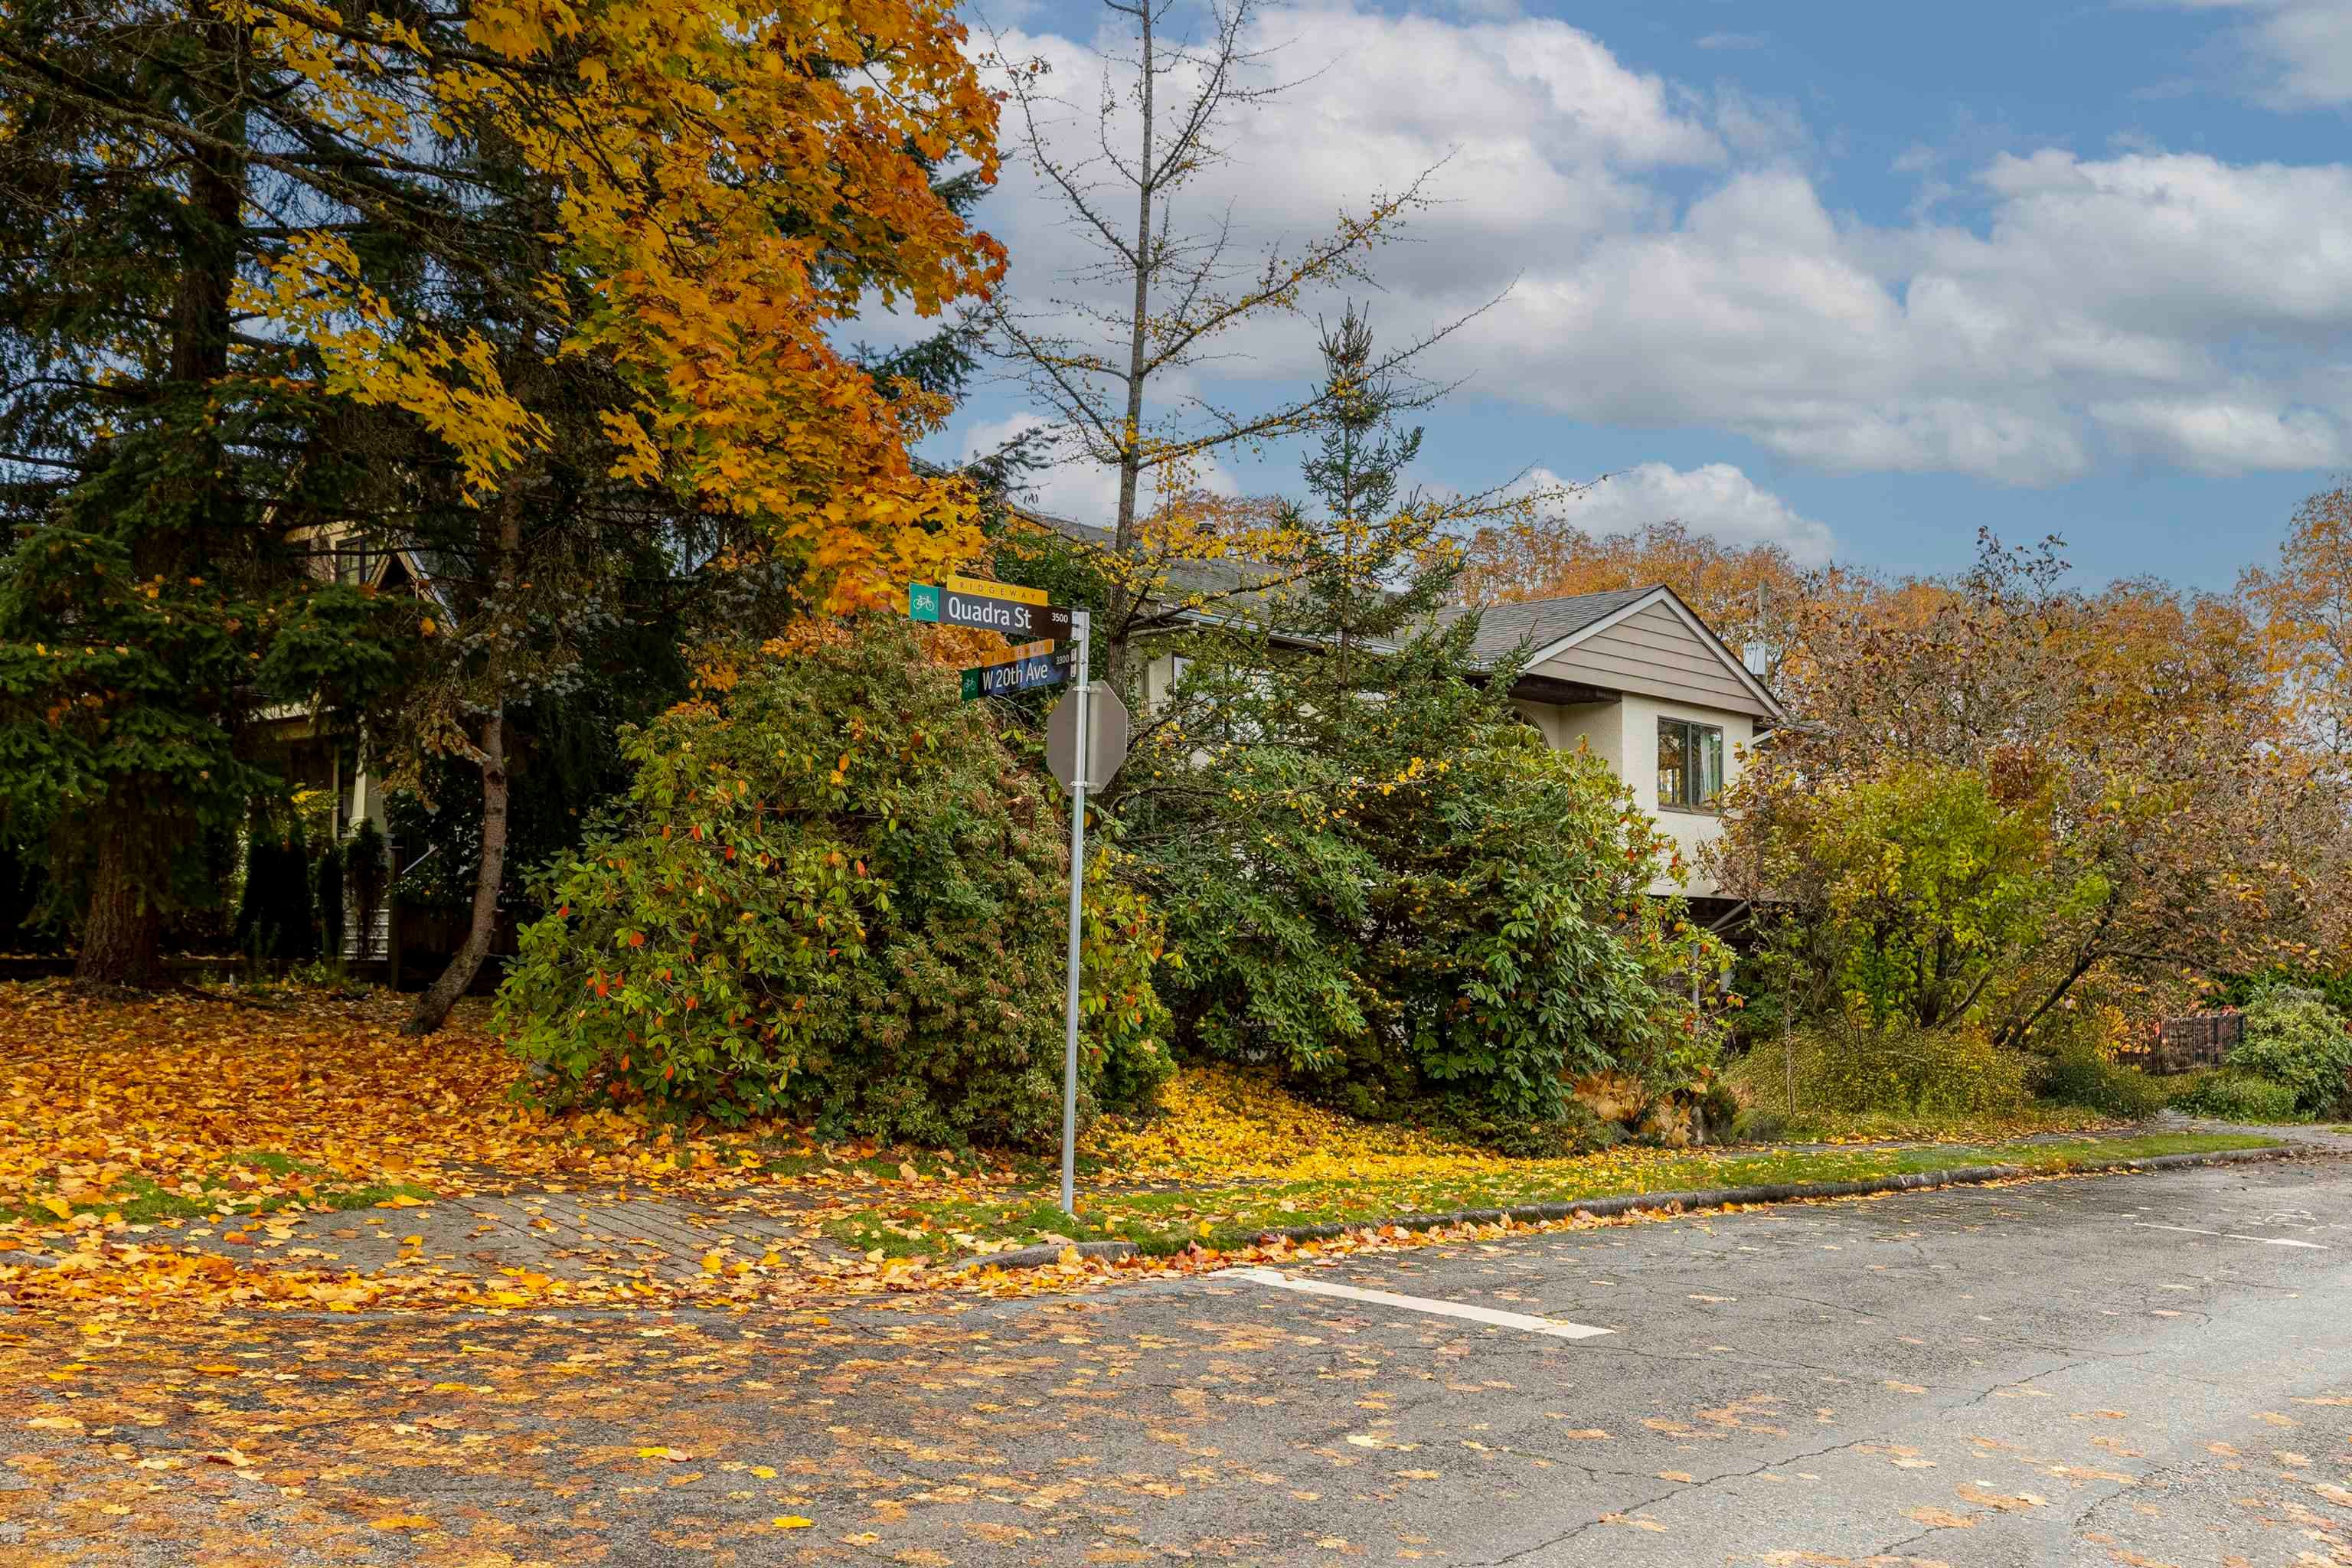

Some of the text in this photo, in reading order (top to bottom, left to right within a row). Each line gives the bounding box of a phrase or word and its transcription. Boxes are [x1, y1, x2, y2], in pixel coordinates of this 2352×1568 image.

[959, 581, 1035, 601] RIDGEWAY
[949, 596, 1032, 629] Quadra St
[1051, 612, 1069, 623] 3500
[1056, 655, 1070, 665] 3300
[982, 662, 1048, 691] W 20th Ave
